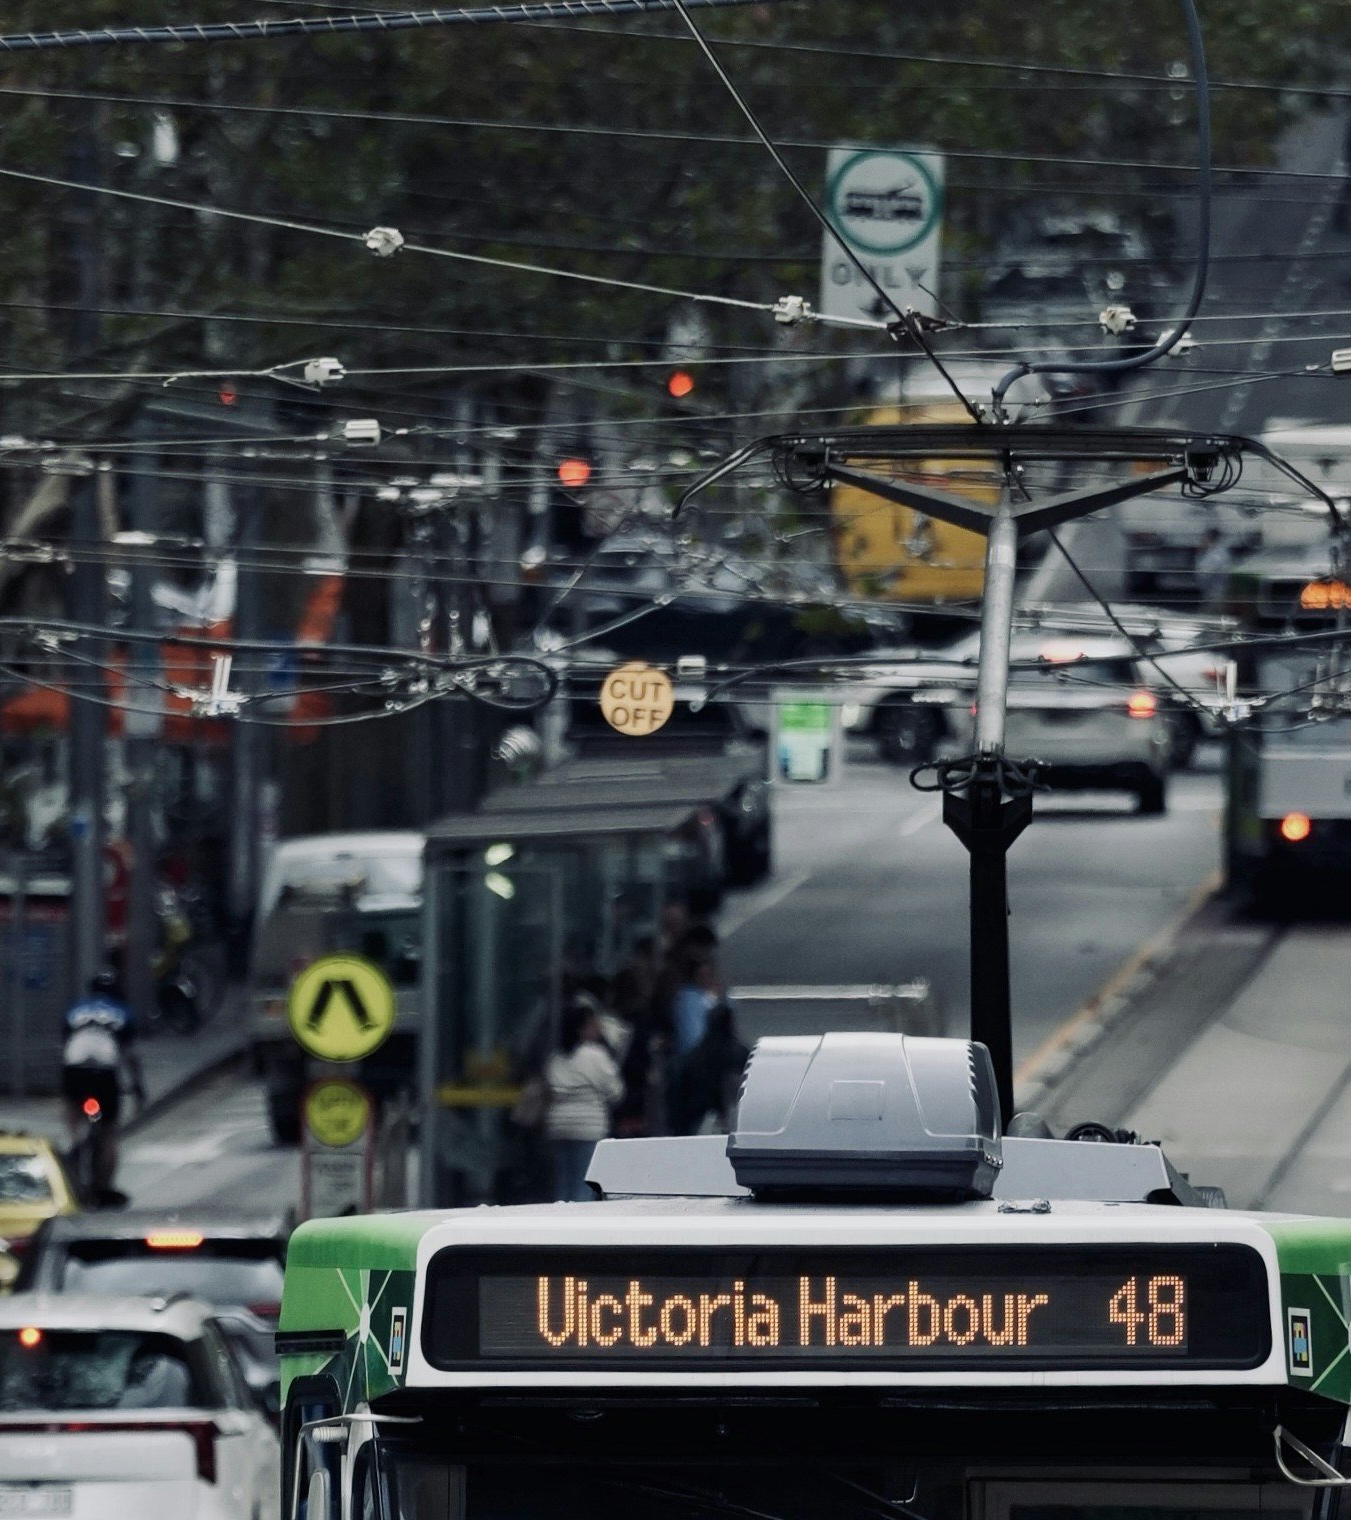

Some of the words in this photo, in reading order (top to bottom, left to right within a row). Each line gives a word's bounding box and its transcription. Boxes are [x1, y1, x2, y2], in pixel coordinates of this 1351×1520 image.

[831, 262, 928, 290] ONLY
[610, 679, 664, 702] CUT
[610, 706, 664, 730] OFF
[537, 1276, 780, 1347] Victoria
[800, 1276, 1049, 1347] Harbour
[1108, 1276, 1187, 1347] 48
